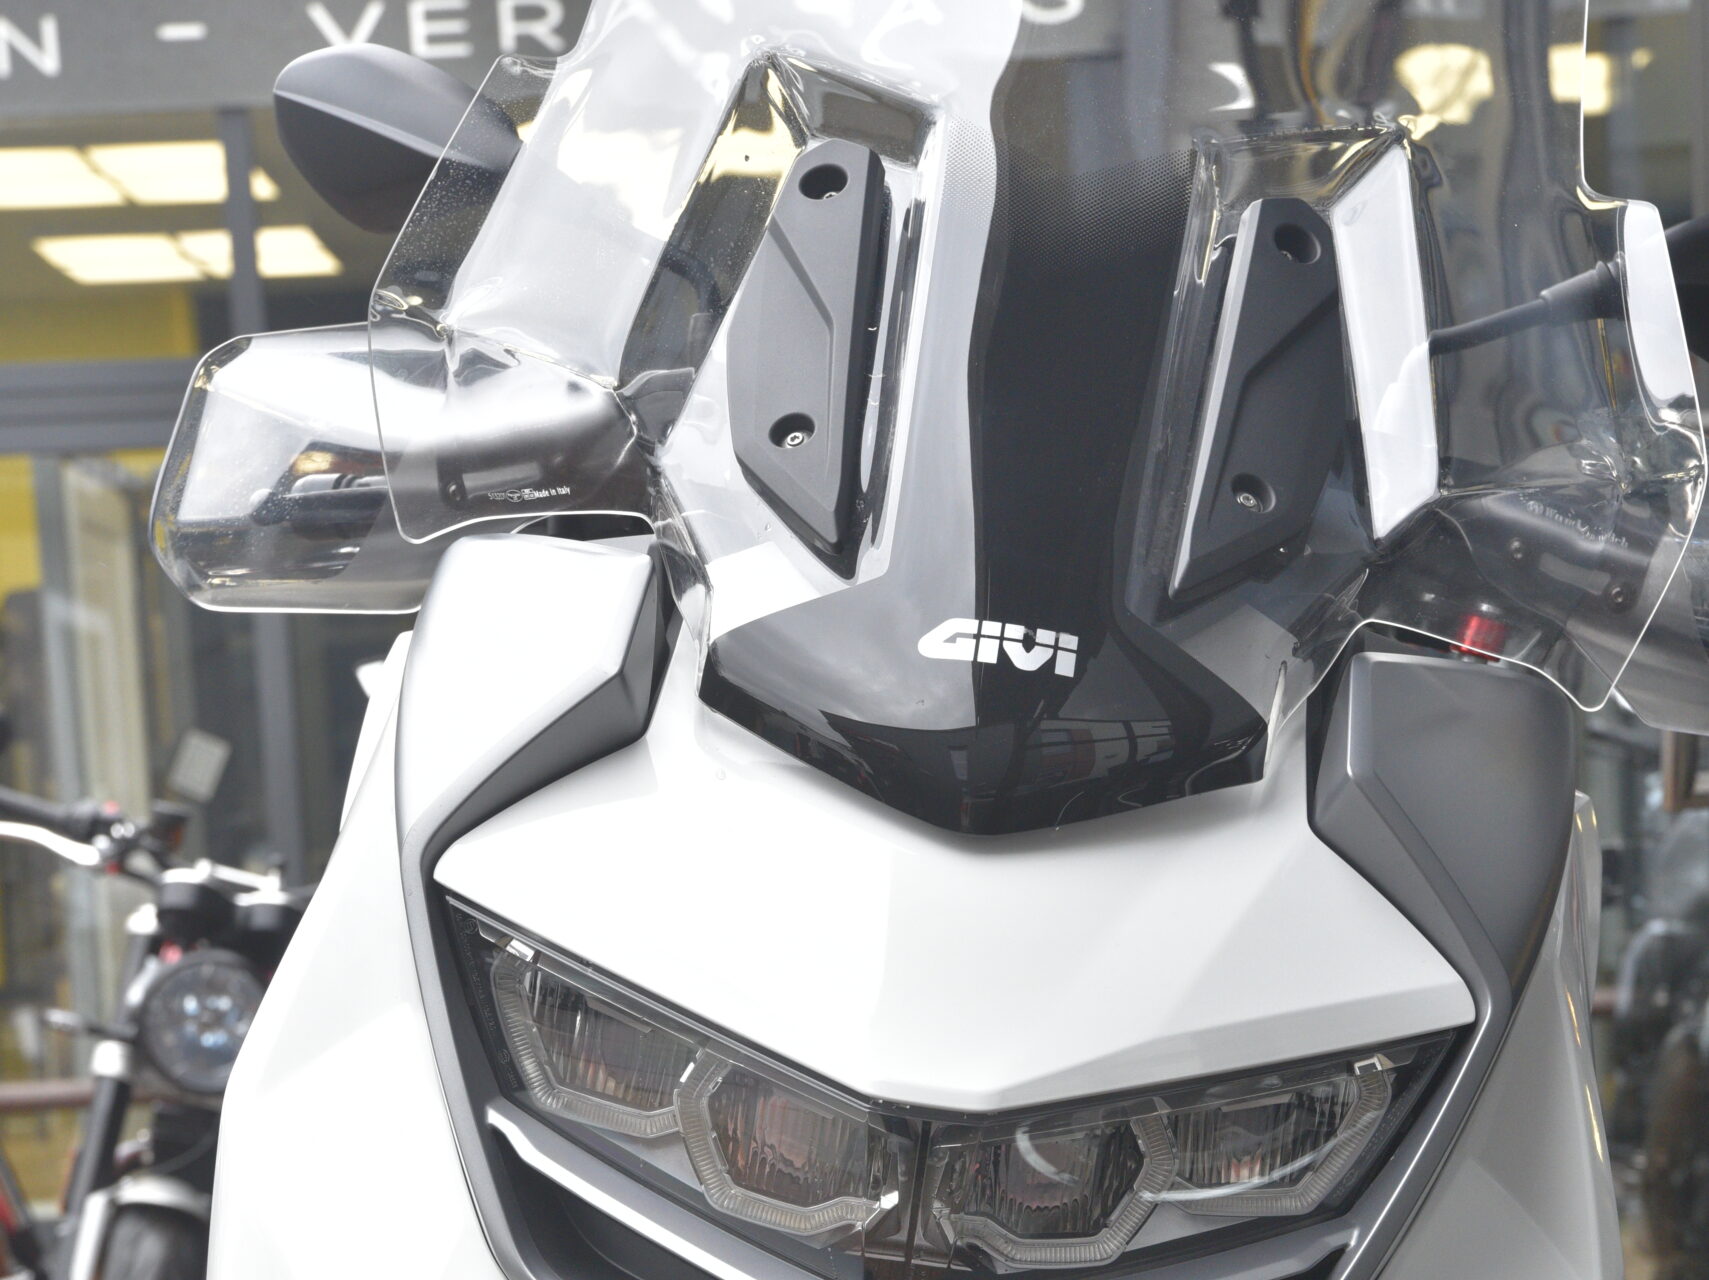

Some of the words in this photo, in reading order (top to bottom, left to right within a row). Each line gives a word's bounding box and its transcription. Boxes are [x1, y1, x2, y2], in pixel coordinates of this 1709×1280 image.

[534, 489, 550, 498] Made
[556, 485, 571, 496] Italy
[917, 617, 1080, 678] GIVI
